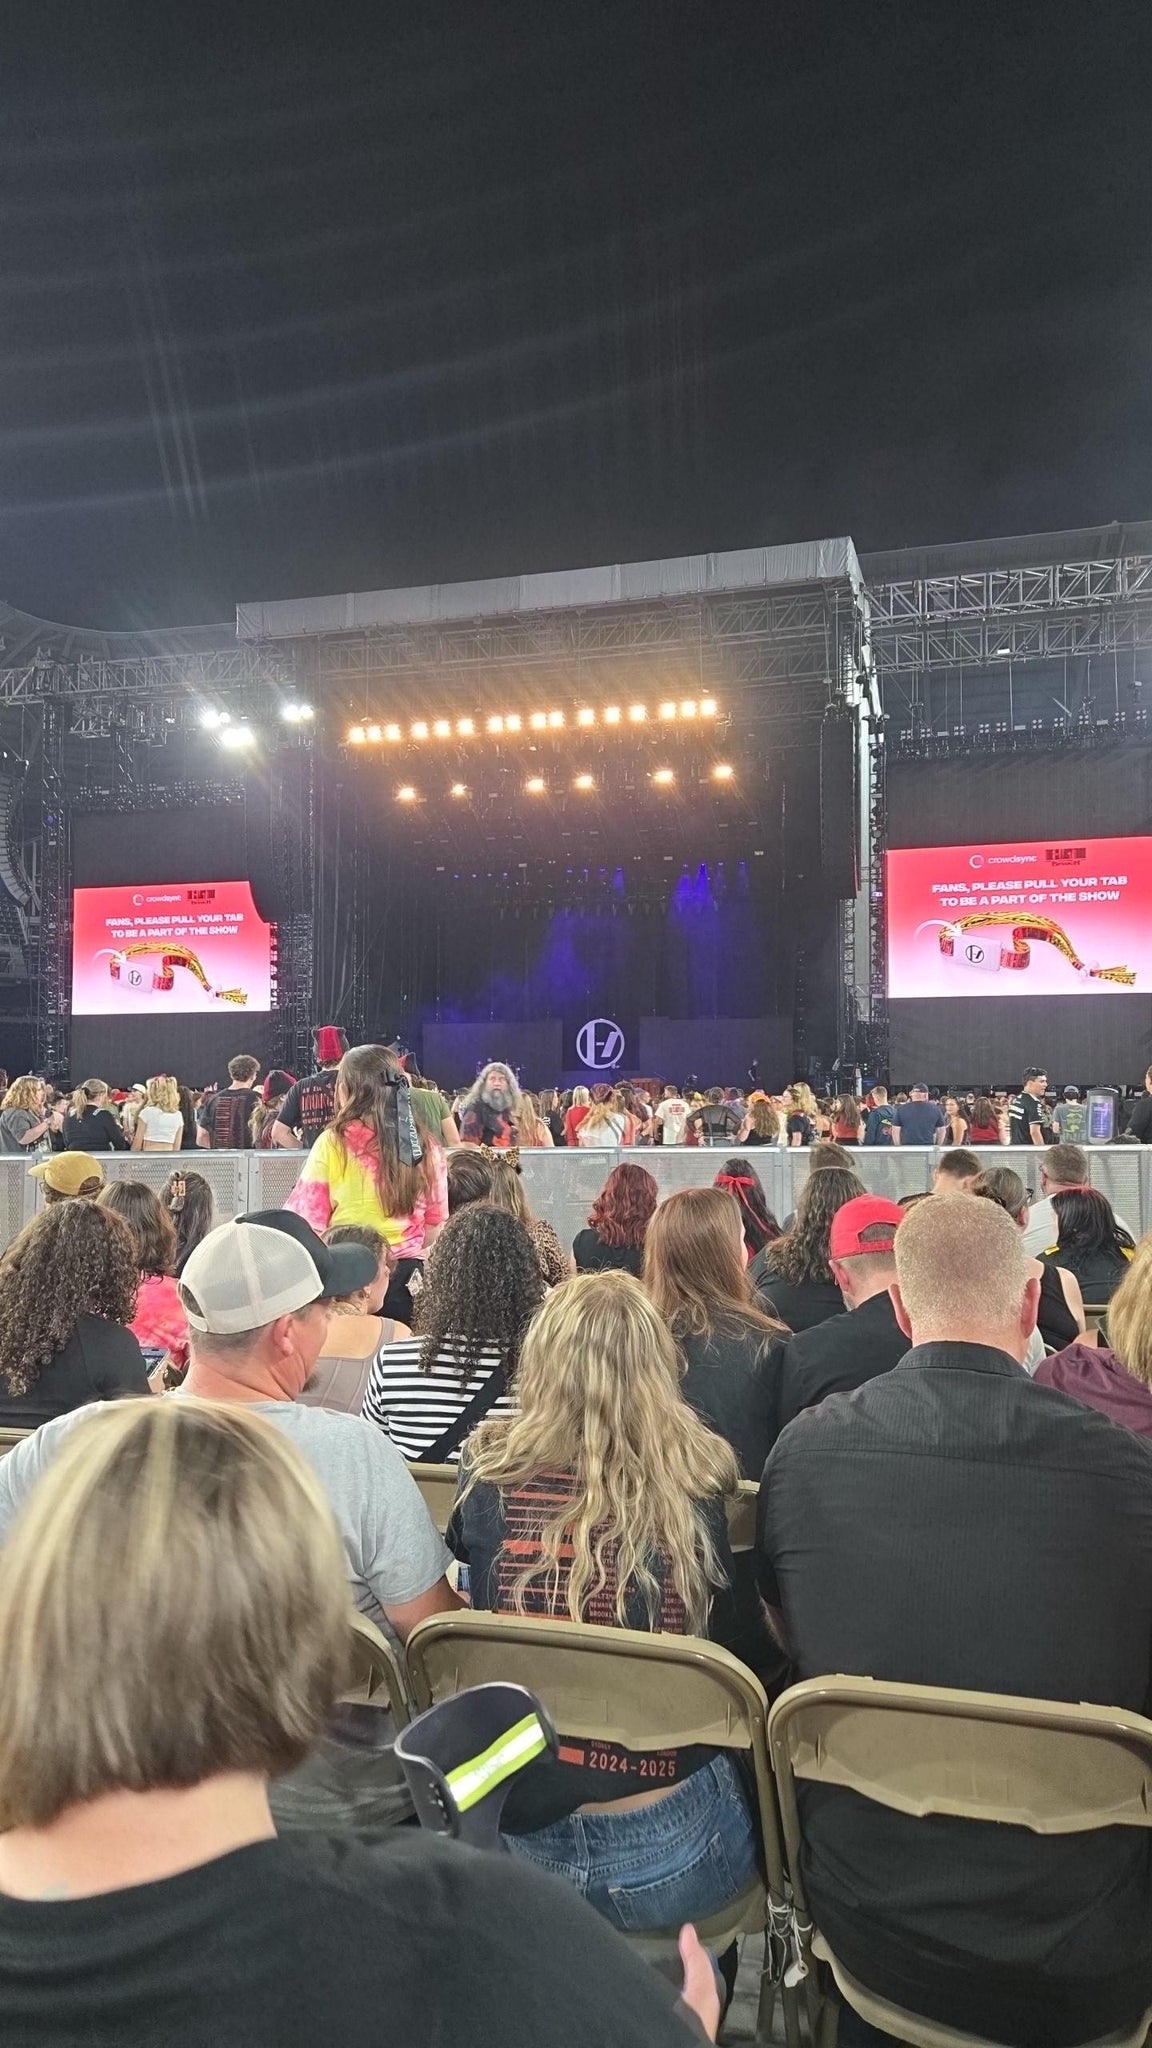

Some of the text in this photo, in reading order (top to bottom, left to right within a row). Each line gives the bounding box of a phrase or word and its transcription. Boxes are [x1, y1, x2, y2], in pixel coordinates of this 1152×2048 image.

[988, 854, 1038, 865] crowdsync
[931, 875, 1128, 894] FANS, PLEASE PULL YOUR TAB
[145, 894, 182, 904] crowdsync
[939, 890, 1121, 907] TO BE A PART OF THE SHOW
[105, 913, 244, 927] FANS, PLEASE PULL YOUR TAB
[111, 925, 239, 939] TO BE A PART OF THE SHOW
[589, 1751, 676, 1777] 2024-2025
